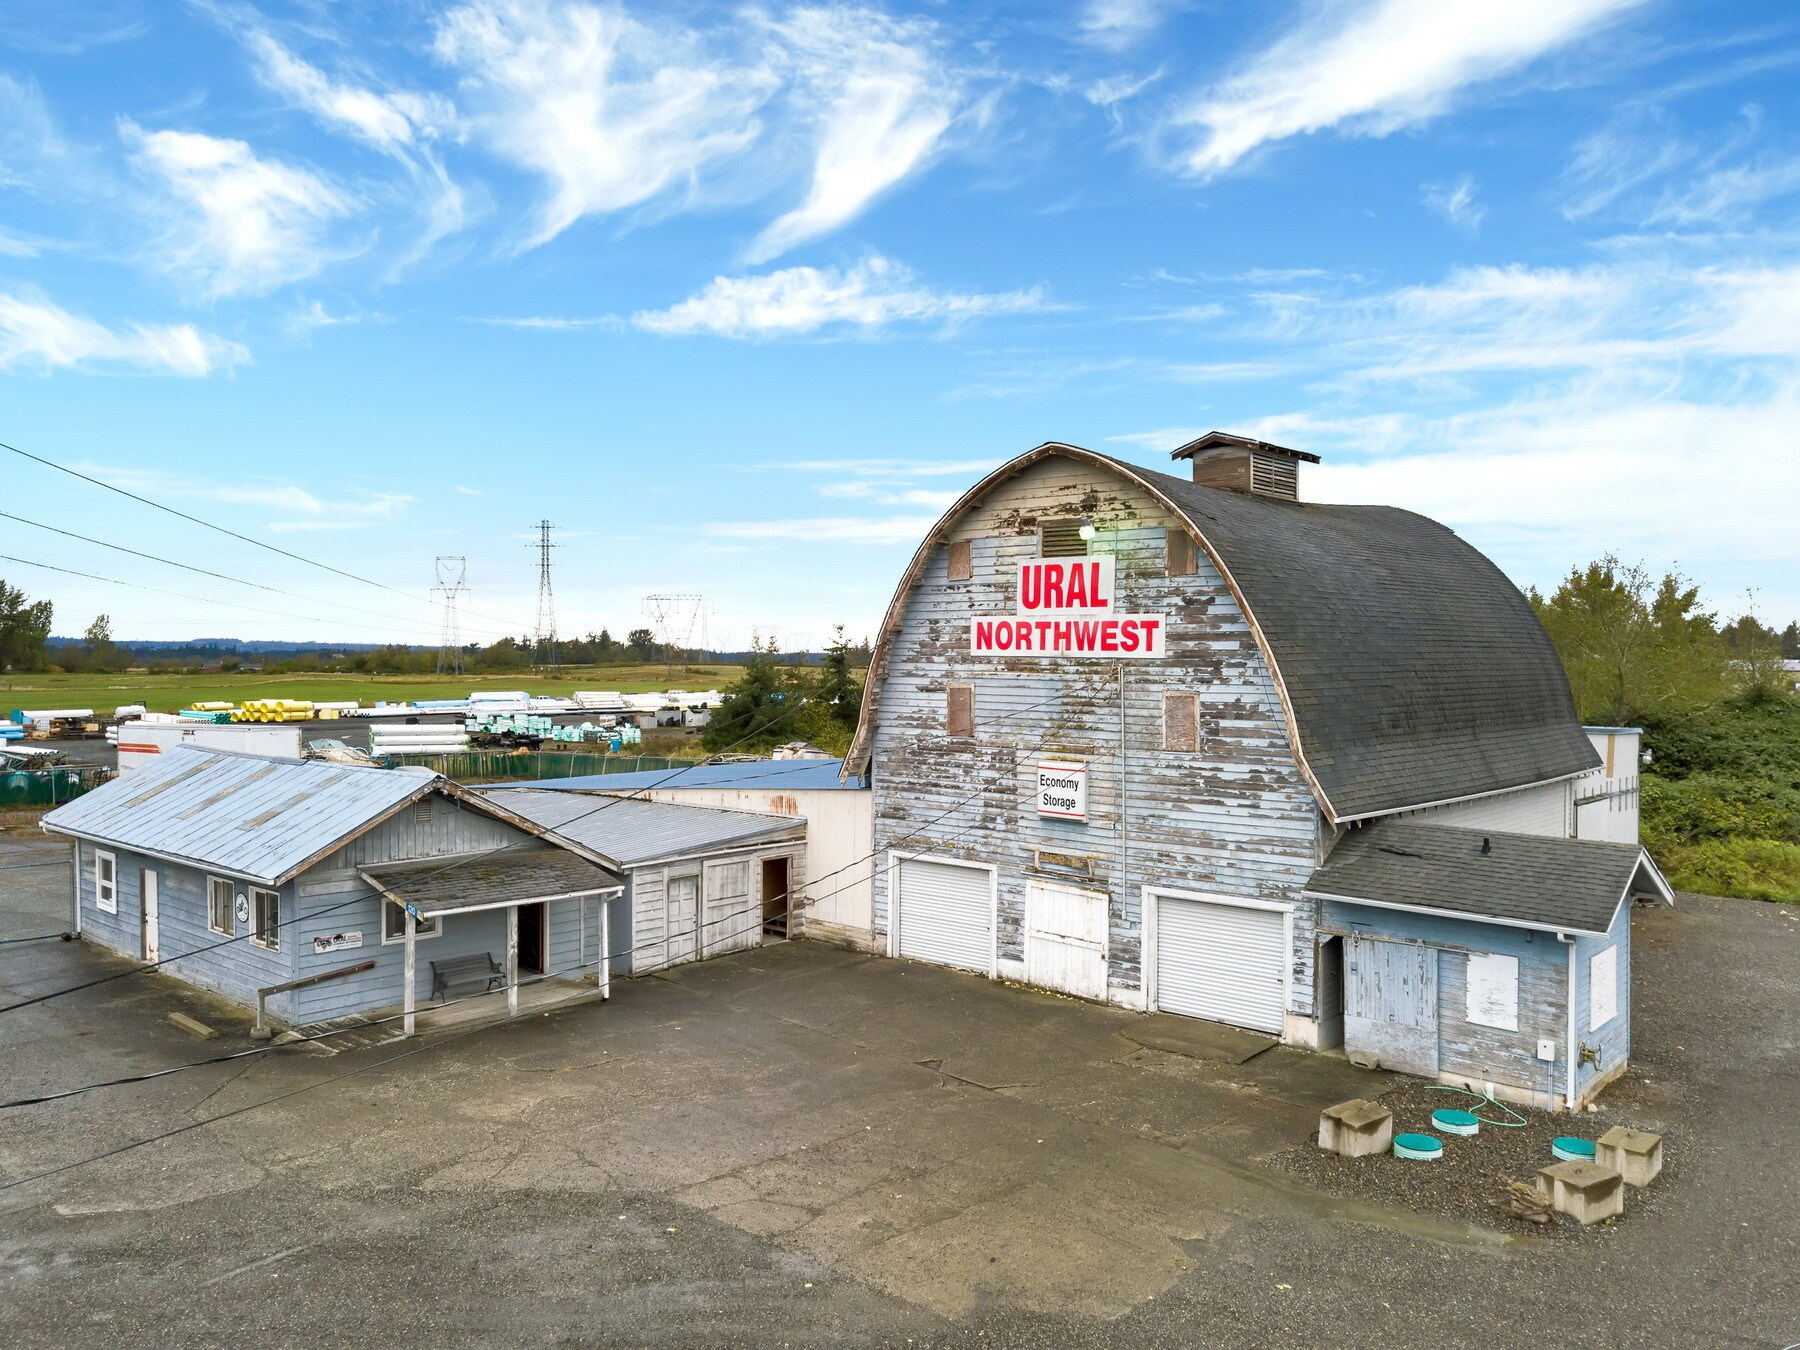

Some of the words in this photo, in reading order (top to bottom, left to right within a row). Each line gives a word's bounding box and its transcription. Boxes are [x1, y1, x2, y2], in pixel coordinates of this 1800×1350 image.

[1021, 562, 1108, 610] URAL
[976, 620, 1159, 652] NORTHWEST
[1040, 774, 1079, 792] Economy
[1043, 793, 1076, 810] Storage
